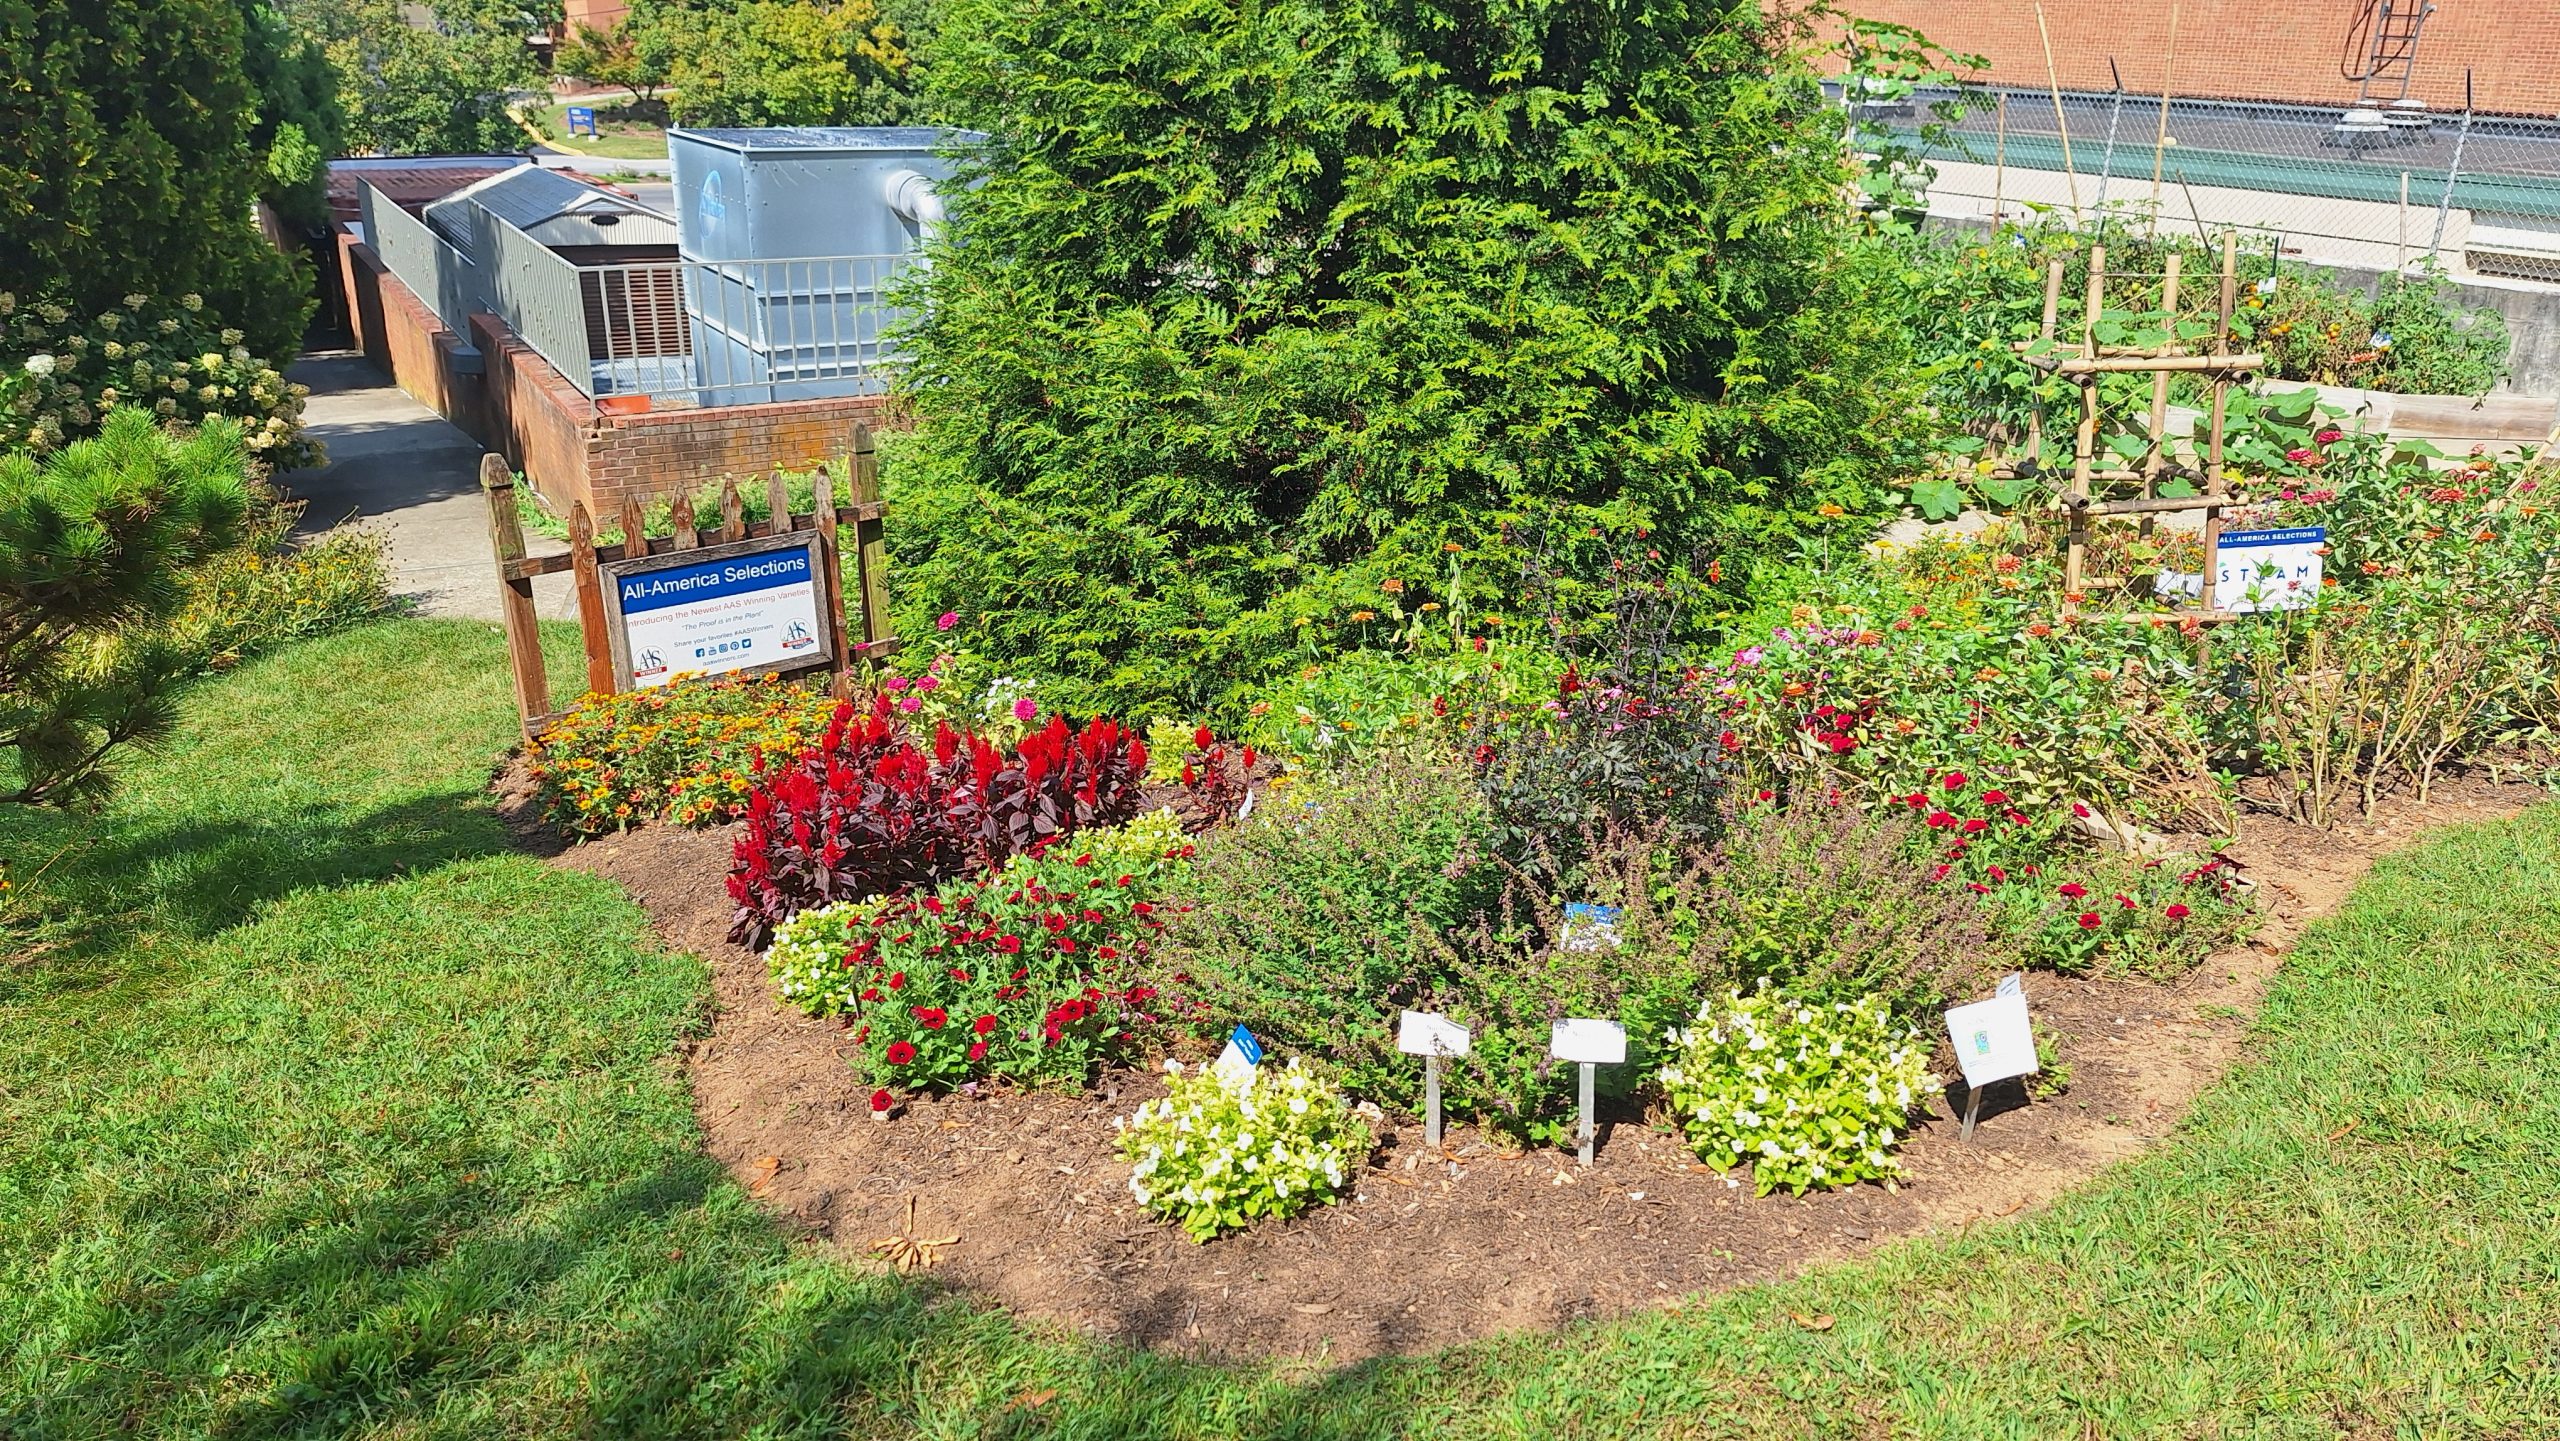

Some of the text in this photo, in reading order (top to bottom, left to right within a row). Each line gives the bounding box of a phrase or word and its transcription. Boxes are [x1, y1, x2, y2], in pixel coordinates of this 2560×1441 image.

[2219, 531, 2317, 543] ALL-AMERICA SELECTIONS
[623, 558, 805, 600] All-America Selections
[2221, 565, 2309, 583] STAM
[627, 589, 810, 628] ntroducing the Newest AAS Winning Varieties
[699, 619, 717, 628] Proof
[673, 640, 692, 648] Share
[693, 637, 707, 645] your
[637, 649, 662, 670] AAS
